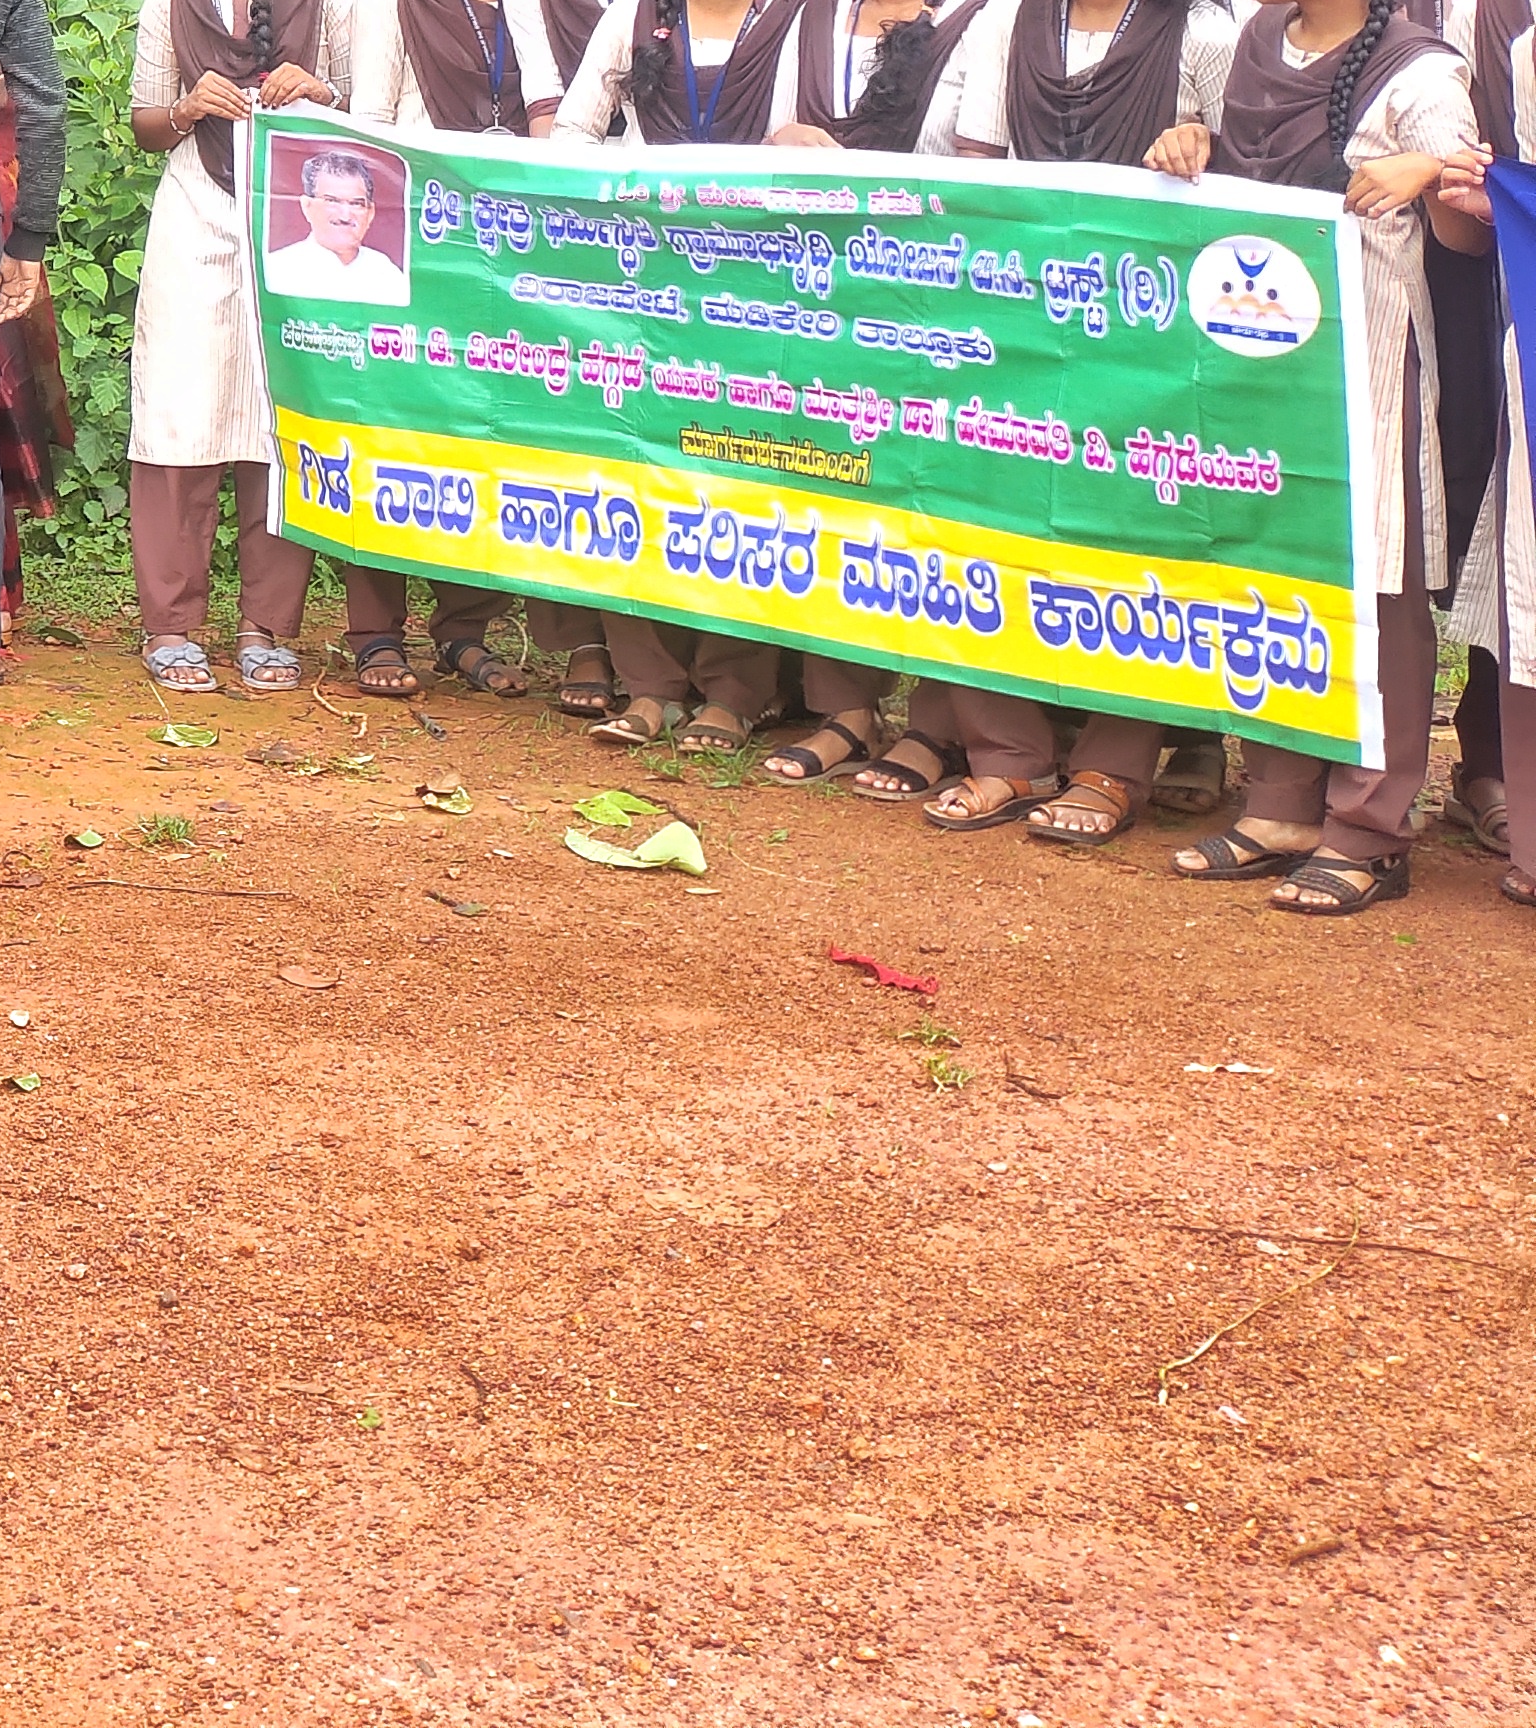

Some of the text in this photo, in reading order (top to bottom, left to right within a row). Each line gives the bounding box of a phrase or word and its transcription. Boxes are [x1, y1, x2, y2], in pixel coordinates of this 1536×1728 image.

[659, 181, 686, 212] ಶ್ರೀ
[422, 180, 462, 242] ಶ್ರೀ
[472, 193, 534, 254] ಕ್ಷೇತ್ರ
[539, 206, 659, 275] ಧರ್ಮಸ್ಥಳ
[662, 222, 834, 296] ಗ್ರಾಮಾಭಿವೃದ್ಧಿ
[846, 226, 966, 287] ಯೋಜನೆ
[1042, 253, 1107, 337] ಟ್ರಸ್ಟ್
[702, 292, 843, 342] ಮಡಿಕೇರಿ
[852, 316, 997, 369] ತಾಲ್ಲೂಕು
[467, 330, 571, 394] ವೀರೇಂದ್ರ
[579, 339, 646, 408] ಹೆಗ್ಗಡೆ
[726, 371, 797, 414] ಹಾಗೂ
[802, 377, 894, 444] ಮಾತೃಶ್ರೀ
[955, 395, 1074, 464] ಹೇಮಾವತಿ
[1125, 428, 1281, 504] ಹೆಗ್ಗಡೆಯವರ
[680, 421, 872, 487] ಮಾರ್ಗದರ್ಶನದೊಂದಿಗೆ
[298, 438, 1331, 712] ಗಿಡ ನಾಟಿ ಹಾಗೂ ಪರಿಸರ ಮಾಹಿತಿ ಕಾರ್ಯಕ್ರಮ
